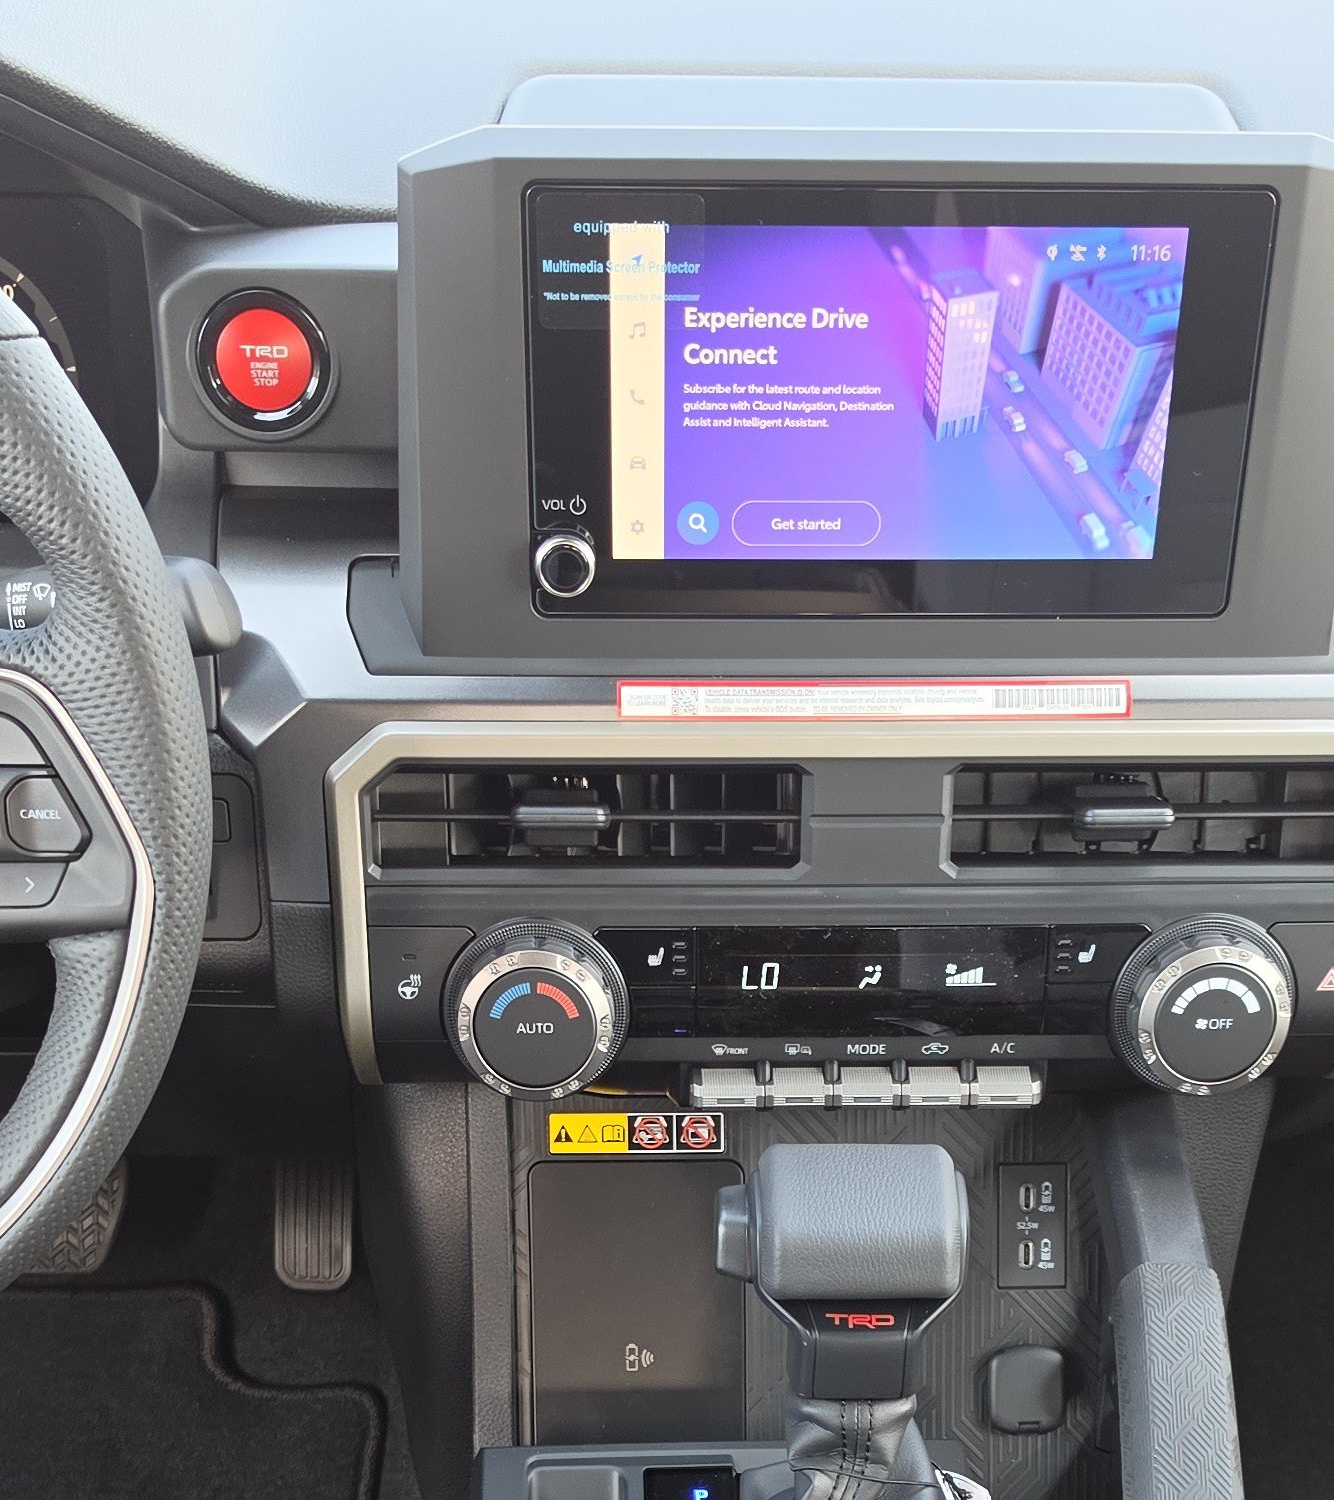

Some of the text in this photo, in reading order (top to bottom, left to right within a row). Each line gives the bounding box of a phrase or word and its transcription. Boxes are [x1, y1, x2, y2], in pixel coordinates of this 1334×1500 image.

[1130, 244, 1171, 262] 11:16
[542, 259, 701, 275] Multimedia Screen Protector
[683, 306, 869, 333] Experience Drive
[240, 345, 289, 358] TRD
[683, 343, 778, 365] Connect
[251, 370, 279, 378] START
[254, 378, 279, 386] STOP
[683, 383, 882, 395] Subscribe for the latest route and location
[683, 401, 894, 413] guidance with Cloud Navigation, Destination
[683, 417, 829, 429] Assist and Intelligent Assistant.
[541, 499, 566, 511] VOL
[771, 518, 841, 531] Get started
[12, 594, 28, 604] OFF
[12, 606, 26, 616] INT
[14, 619, 25, 628] LO
[19, 809, 61, 820] CANCEL
[741, 962, 780, 990] LO
[516, 1022, 554, 1034] AUTO
[1208, 1018, 1233, 1030] OFF
[726, 1047, 749, 1055] FRONT
[847, 1044, 886, 1056] MODE
[990, 1042, 1015, 1054] A/C
[825, 1313, 895, 1329] TRD
